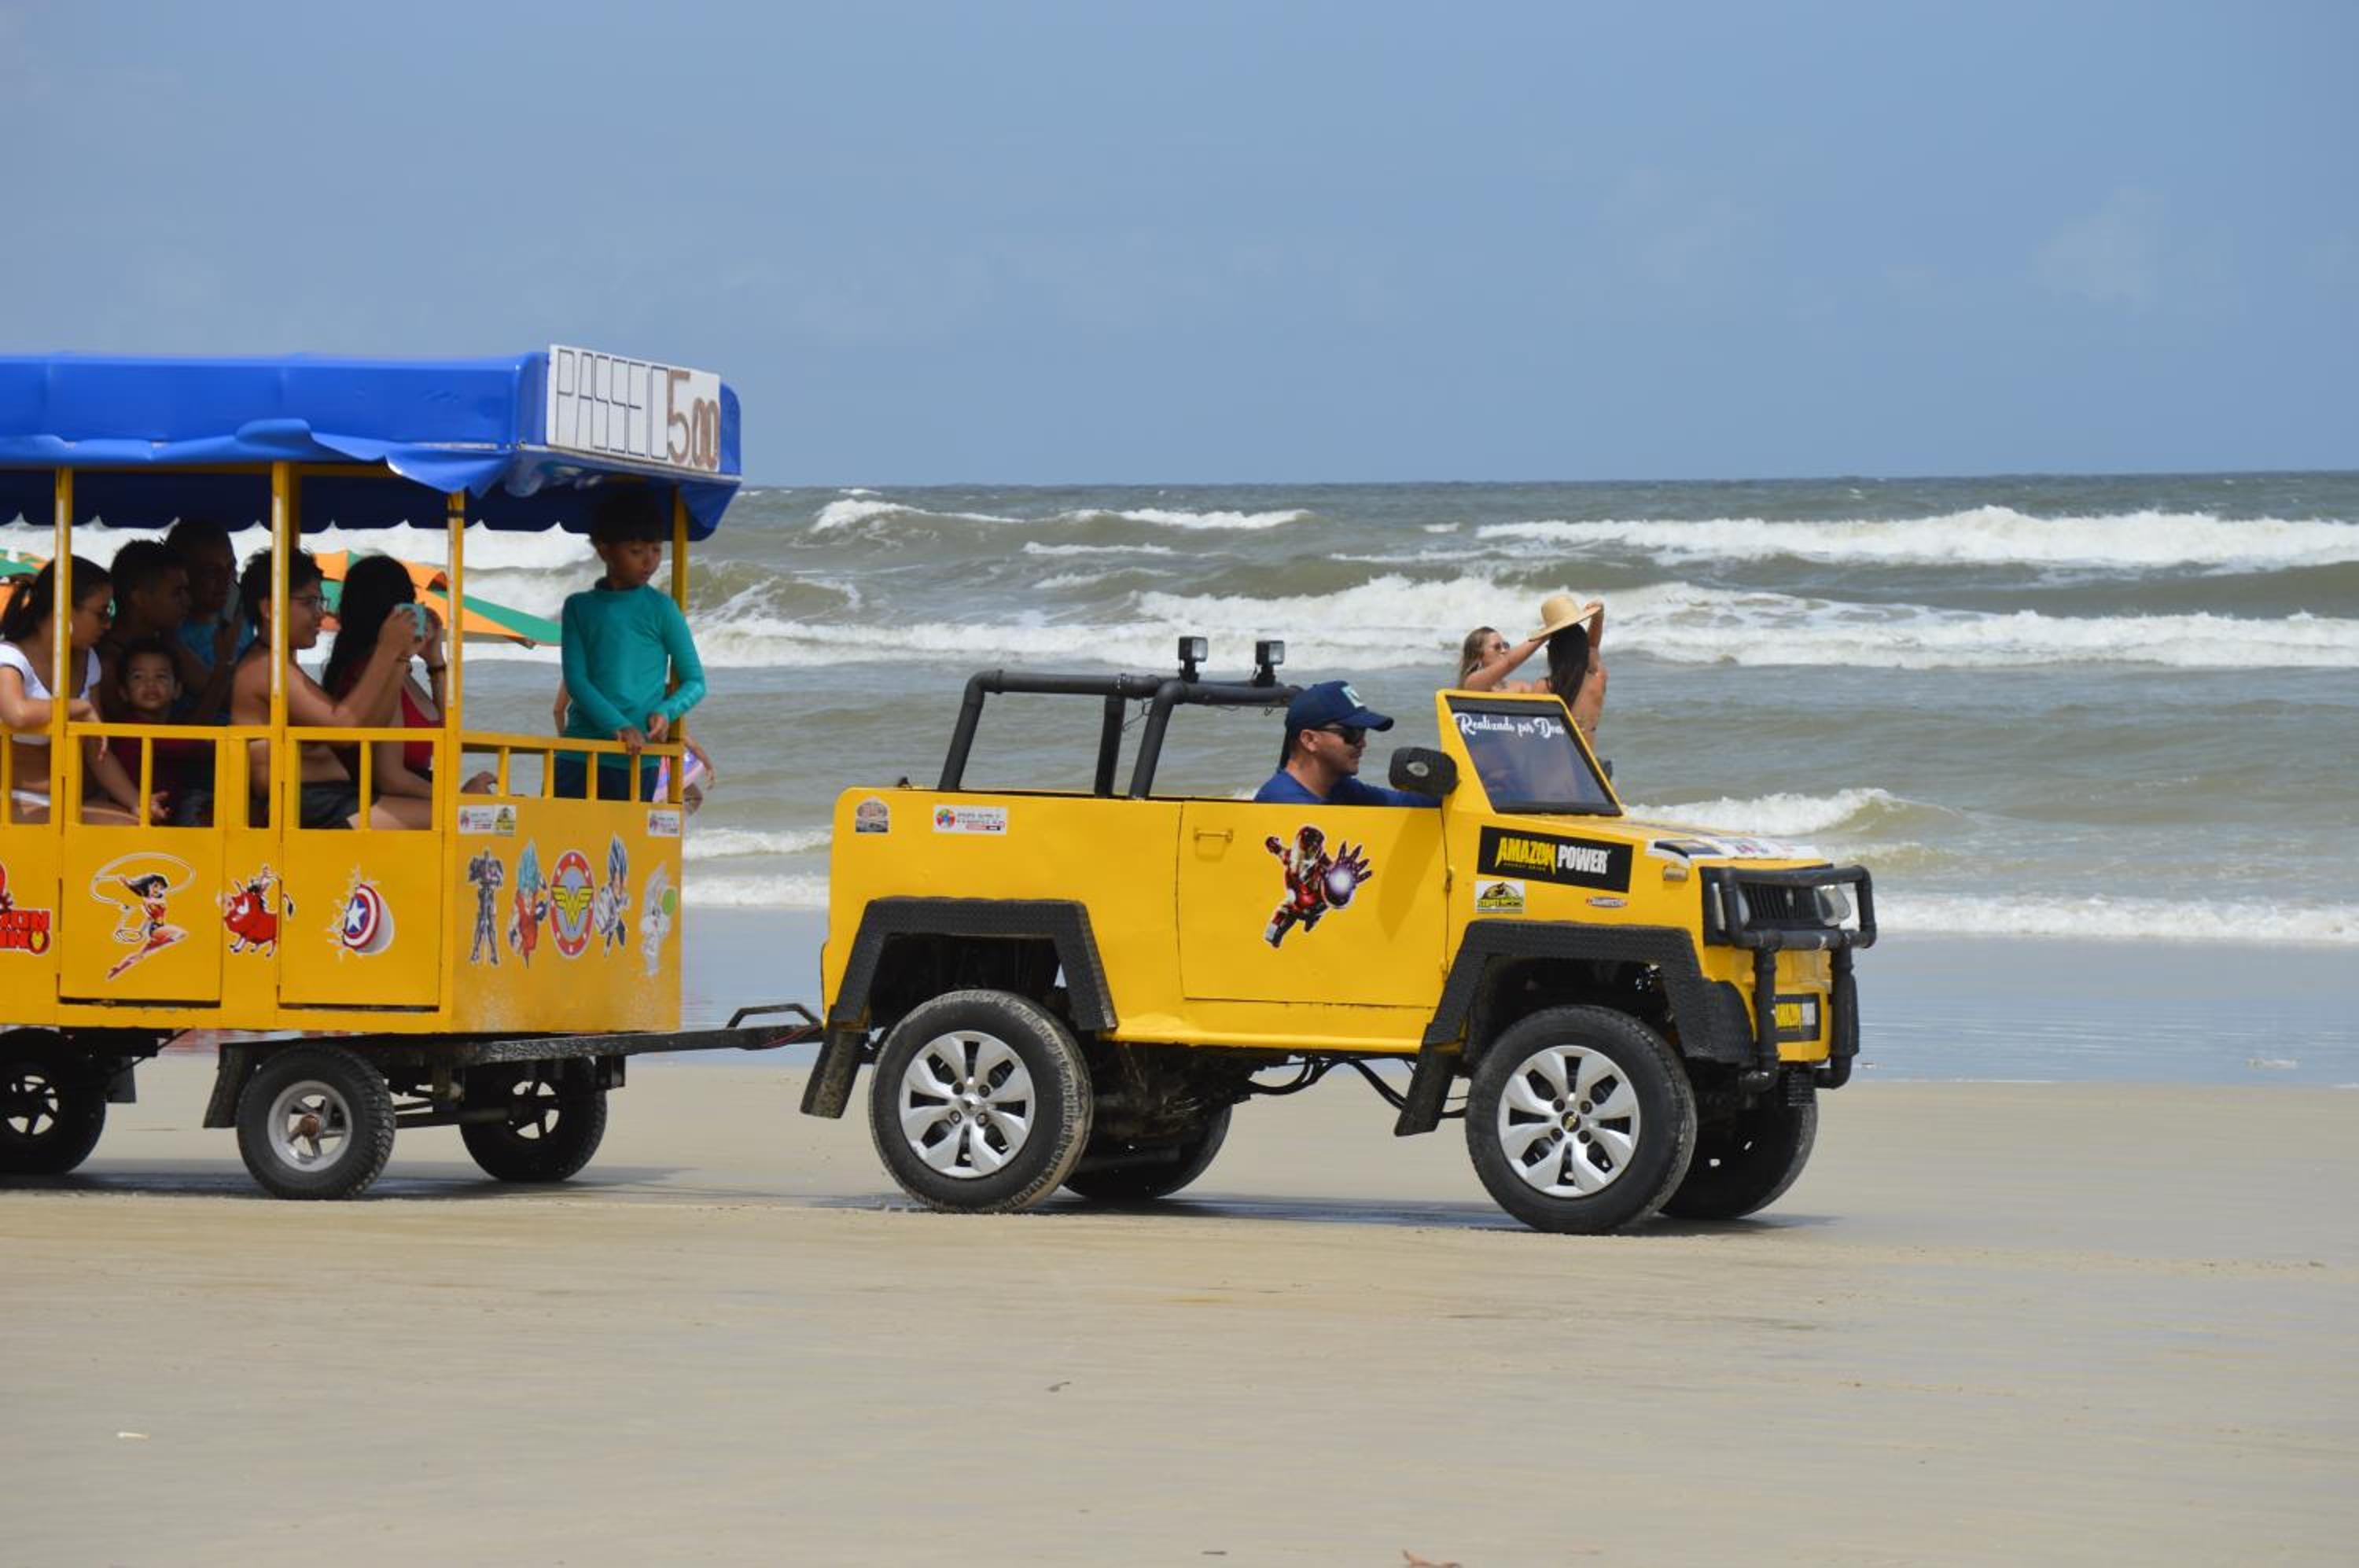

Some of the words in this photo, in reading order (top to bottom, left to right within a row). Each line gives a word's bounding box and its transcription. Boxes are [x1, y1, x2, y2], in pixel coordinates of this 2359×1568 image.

[1452, 712, 1515, 735] Realizado
[1517, 721, 1535, 737] por
[1494, 837, 1556, 875] AMAZON
[1557, 844, 1609, 874] POWER
